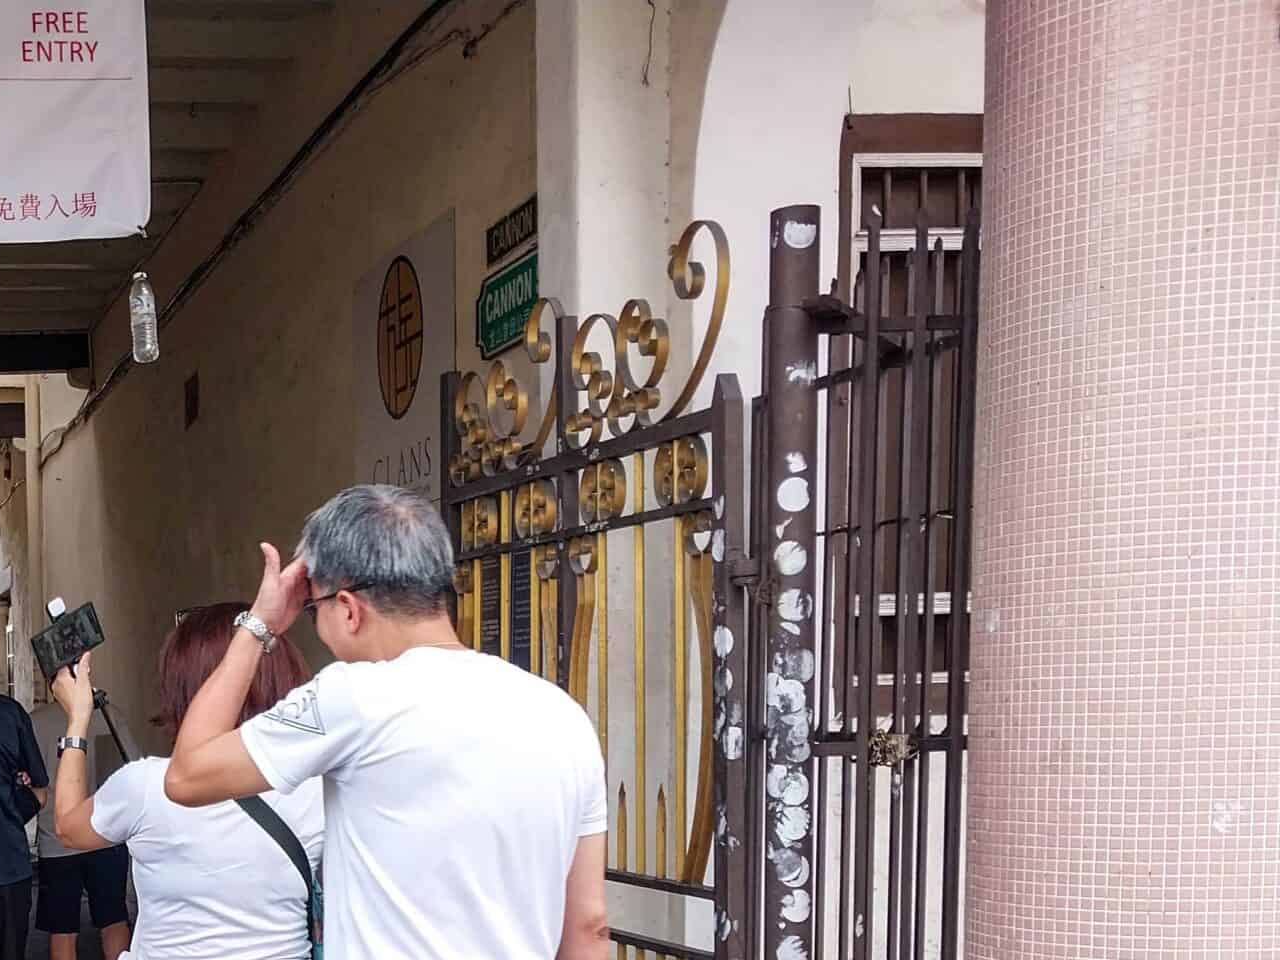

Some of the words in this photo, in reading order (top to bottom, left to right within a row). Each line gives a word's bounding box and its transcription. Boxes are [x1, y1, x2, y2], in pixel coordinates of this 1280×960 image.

[31, 12, 89, 34] FREE
[22, 41, 99, 63] ENTRY
[491, 205, 533, 256] CANNON
[486, 268, 532, 323] CANNON
[372, 436, 432, 486] CLANS
